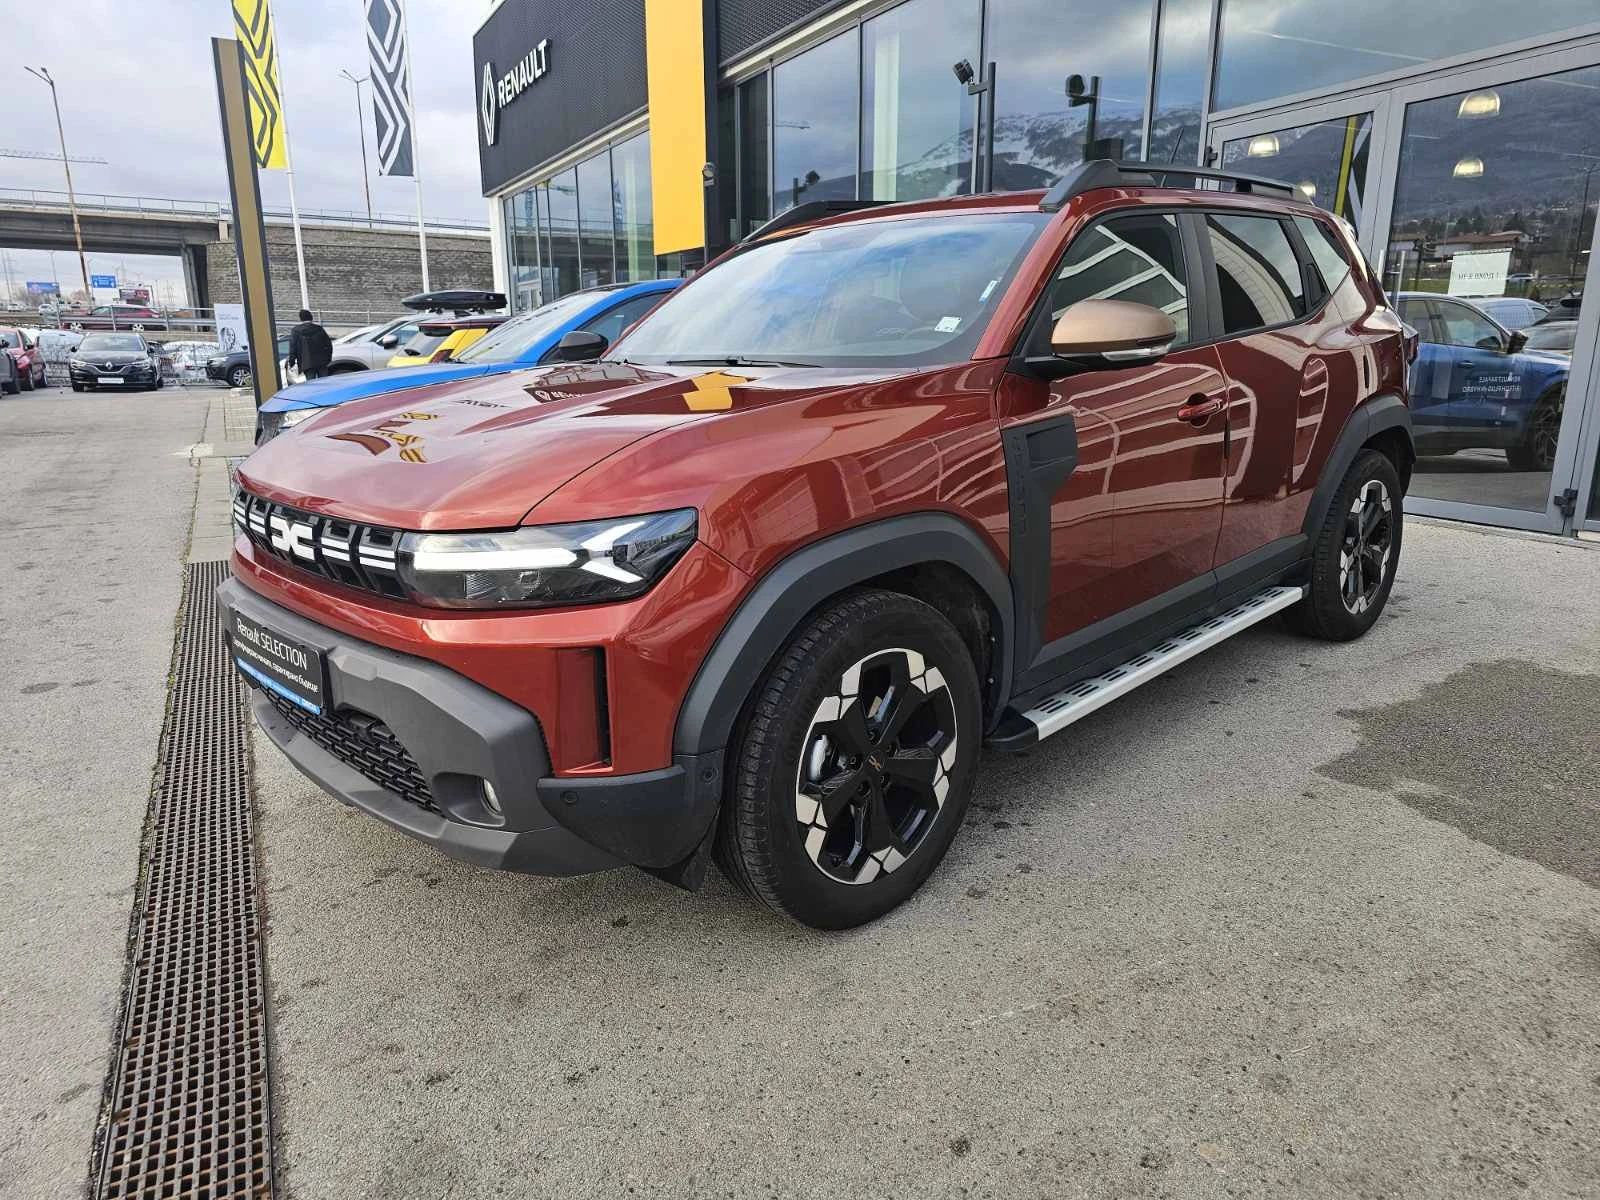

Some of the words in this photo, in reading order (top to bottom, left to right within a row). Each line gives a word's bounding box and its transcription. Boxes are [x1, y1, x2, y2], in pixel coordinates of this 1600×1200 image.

[497, 38, 548, 108] RENAULT
[236, 617, 261, 647] Renault
[260, 632, 307, 670] SELECTION
